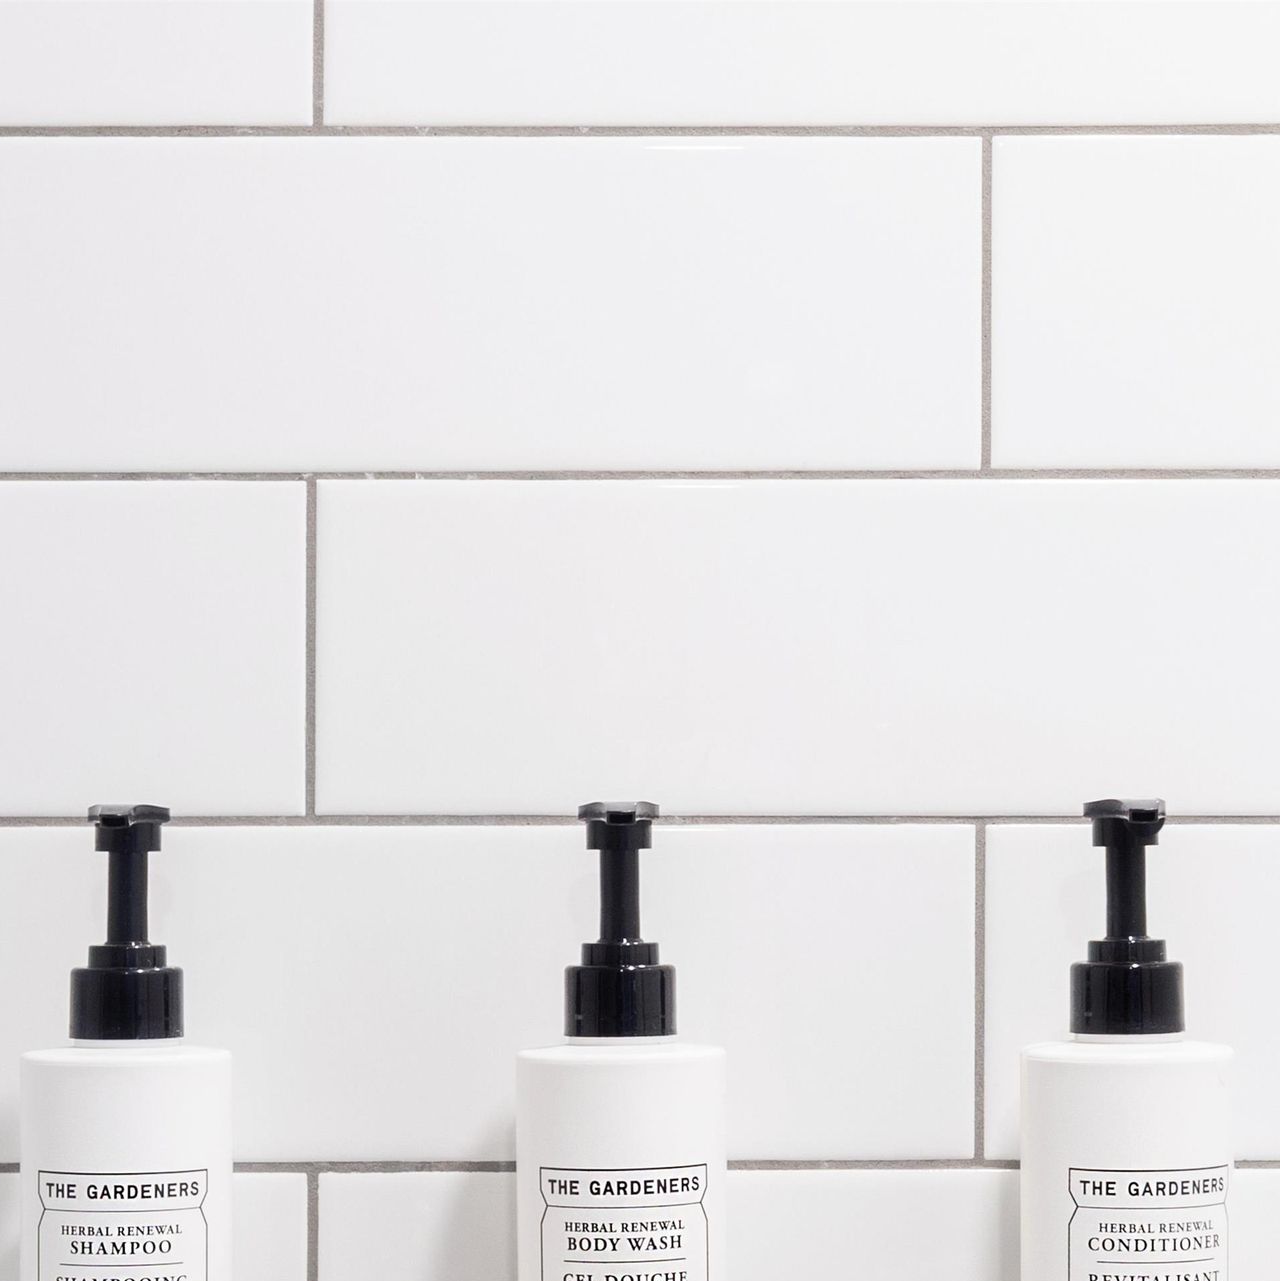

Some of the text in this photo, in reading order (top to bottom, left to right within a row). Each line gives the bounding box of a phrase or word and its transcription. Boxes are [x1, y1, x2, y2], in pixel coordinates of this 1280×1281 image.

[46, 1181, 199, 1200] THE GARDENERS
[548, 1176, 700, 1196] THE GARDENERS
[1080, 1177, 1224, 1196] THE GARDENERS
[61, 1224, 182, 1237] HERBAL RENEWAL
[564, 1220, 685, 1233] HERBAL RENEWAL
[1099, 1220, 1214, 1234] HERBAL RENEWAL
[70, 1240, 172, 1255] SHAMPOO
[567, 1235, 682, 1252] BODY WASH
[1088, 1235, 1220, 1252] CONDITIONER
